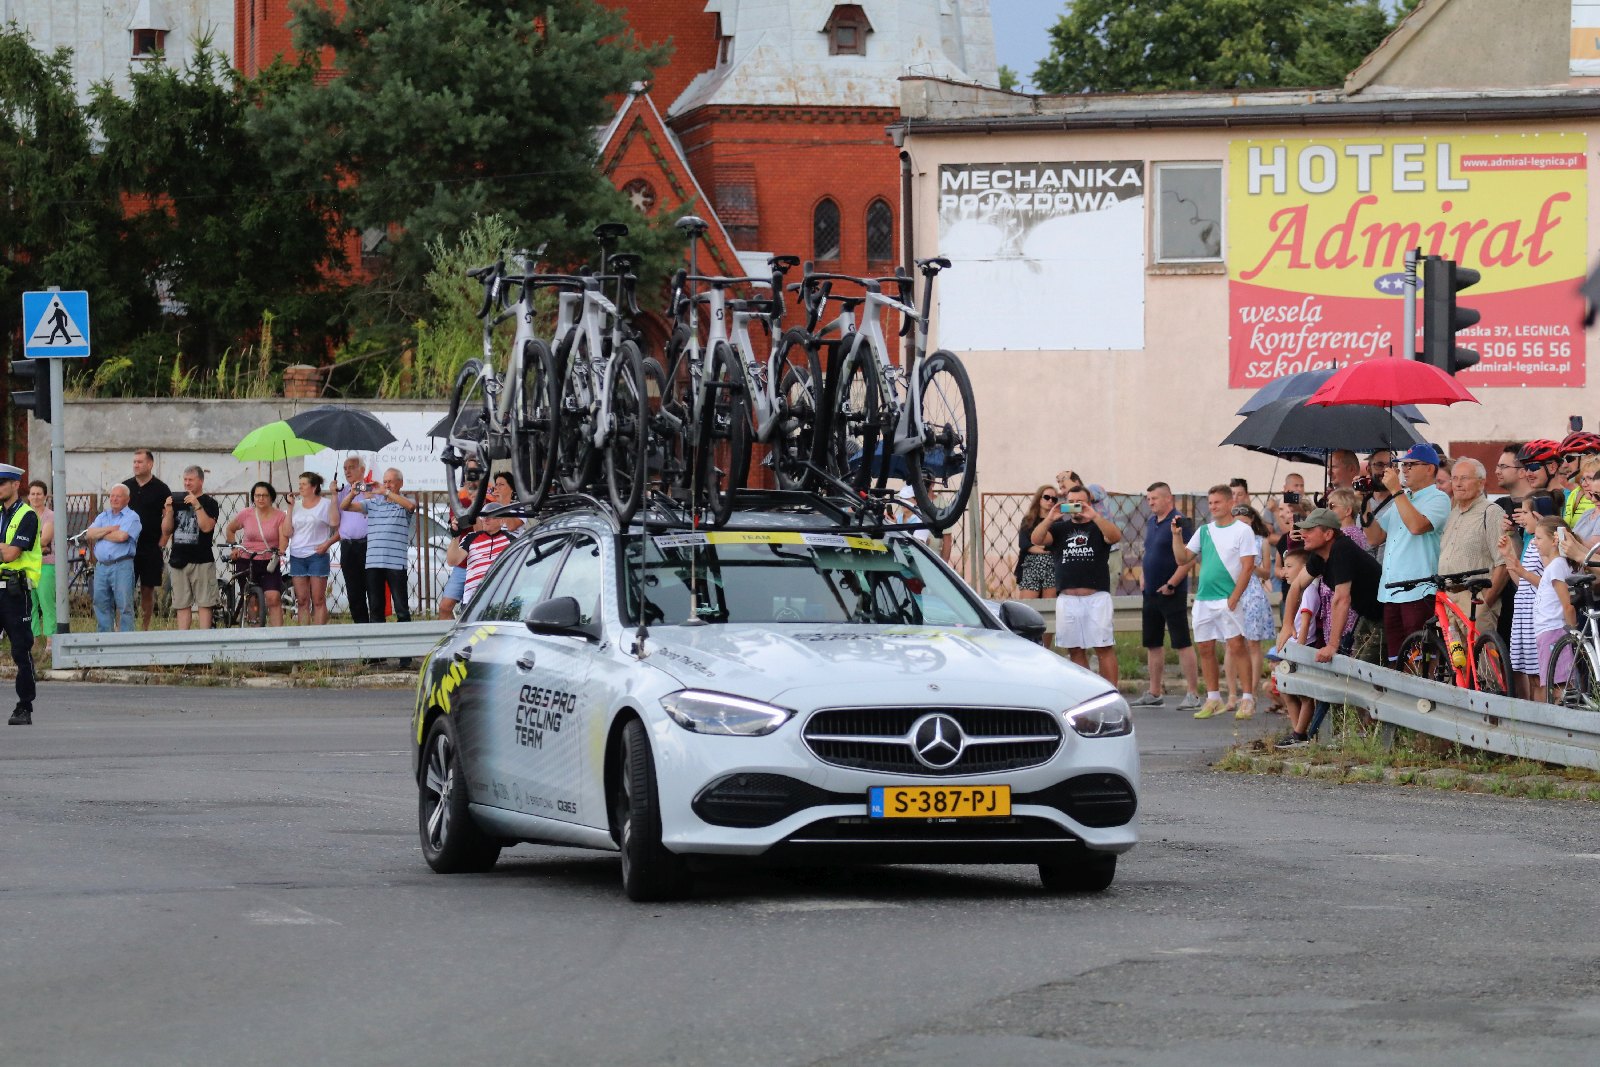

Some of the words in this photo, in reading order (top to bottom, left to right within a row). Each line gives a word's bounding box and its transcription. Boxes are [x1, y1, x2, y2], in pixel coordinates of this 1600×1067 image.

[1248, 144, 1468, 194] HOTEL
[1463, 156, 1578, 168] www.admiral-legnica.pl
[941, 168, 1142, 190] MECHANIKA
[941, 192, 1120, 211] POJAZDOWA
[1239, 192, 1571, 280] Admirał
[1239, 296, 1323, 324] wesela
[1250, 323, 1392, 358] konferencje
[1494, 327, 1512, 339] 37,
[1515, 325, 1570, 336] LEGNICA
[1483, 342, 1517, 357] 506
[1522, 342, 1544, 357] 56
[1549, 342, 1571, 357] 56
[1461, 361, 1571, 374] admiral-legnica.pl
[1062, 547, 1094, 555] KANADA
[551, 690, 577, 714] PRO
[515, 705, 562, 733] CYCLING
[515, 725, 543, 750] TEAM
[872, 805, 882, 813] NL
[894, 790, 996, 813] S-387-PJ
